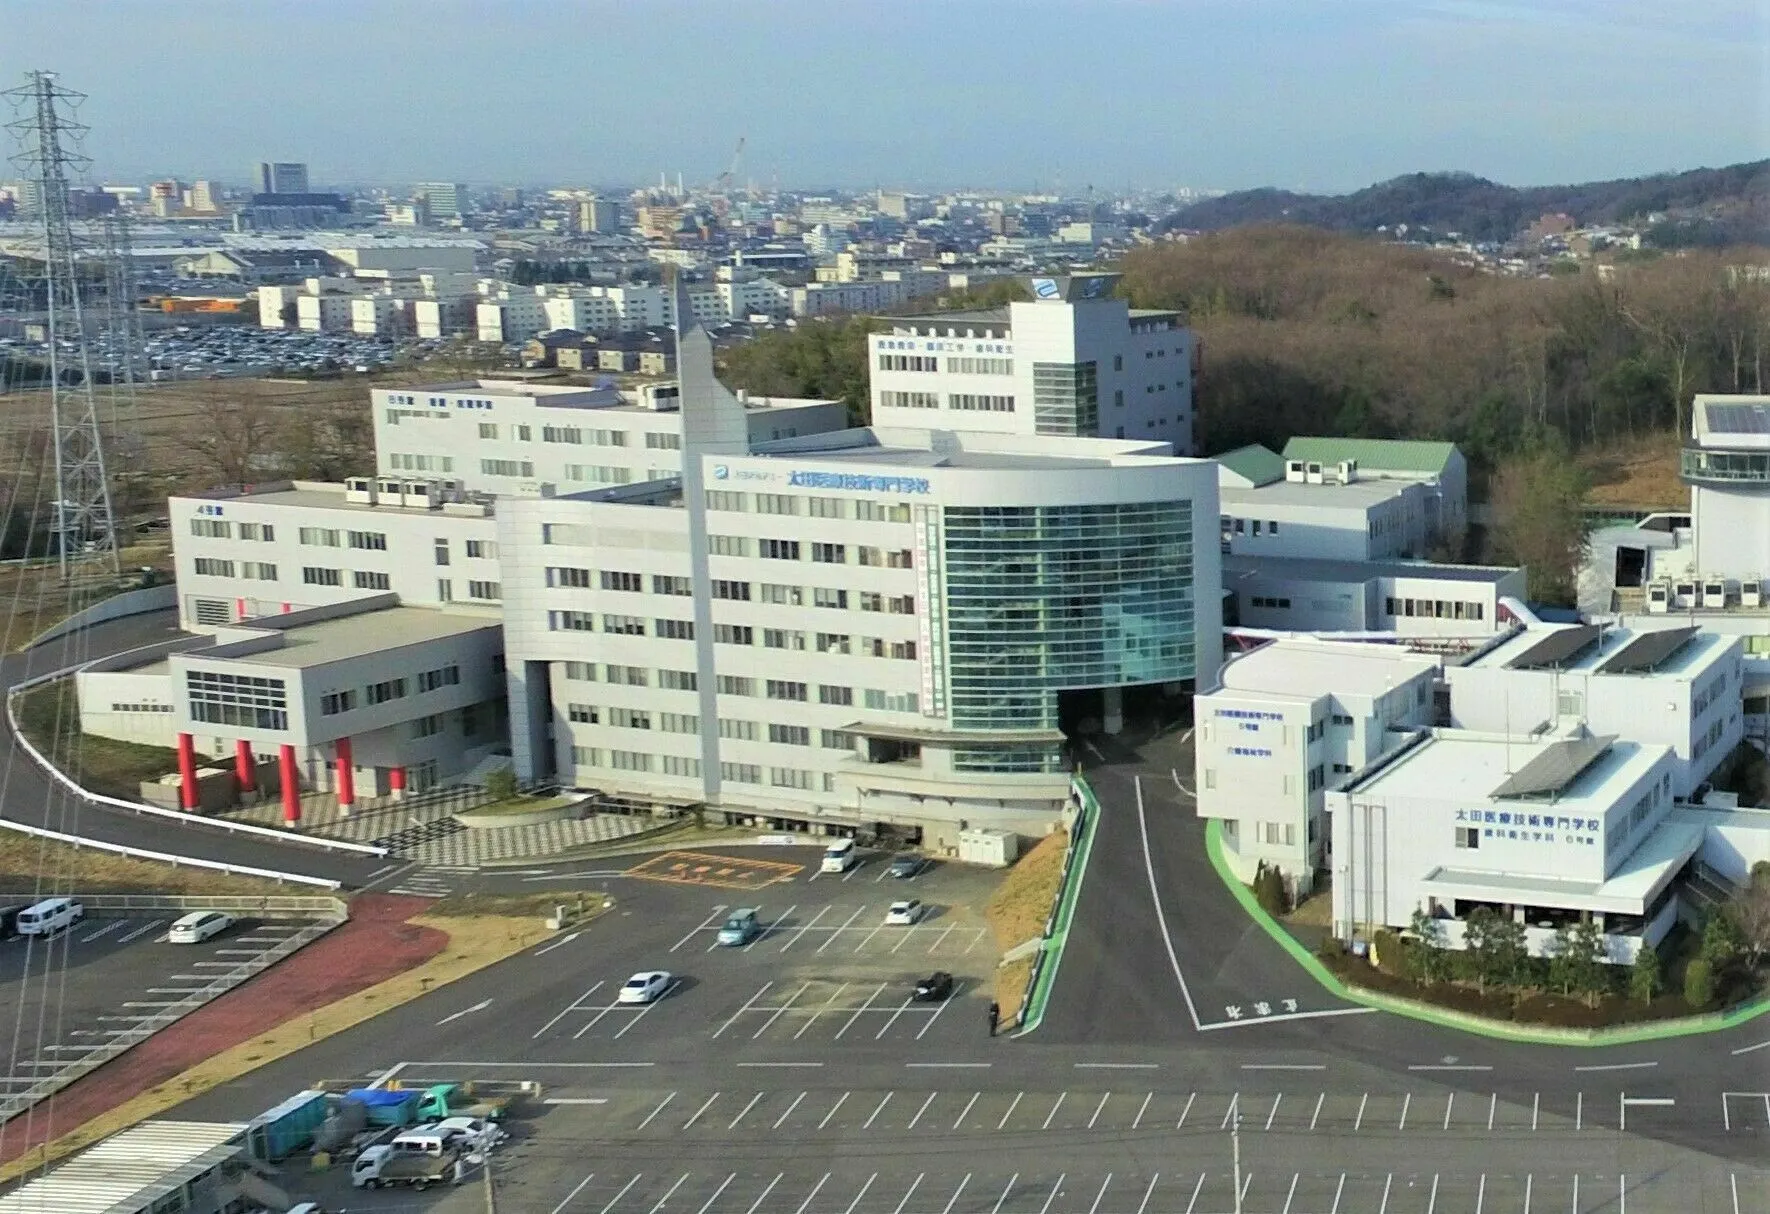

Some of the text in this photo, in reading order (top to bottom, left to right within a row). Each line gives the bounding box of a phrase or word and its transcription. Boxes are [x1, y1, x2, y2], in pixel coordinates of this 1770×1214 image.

[1455, 808, 1600, 832] 太田医療技術専門学校
[1484, 828, 1555, 843] 歯科衛生学科
